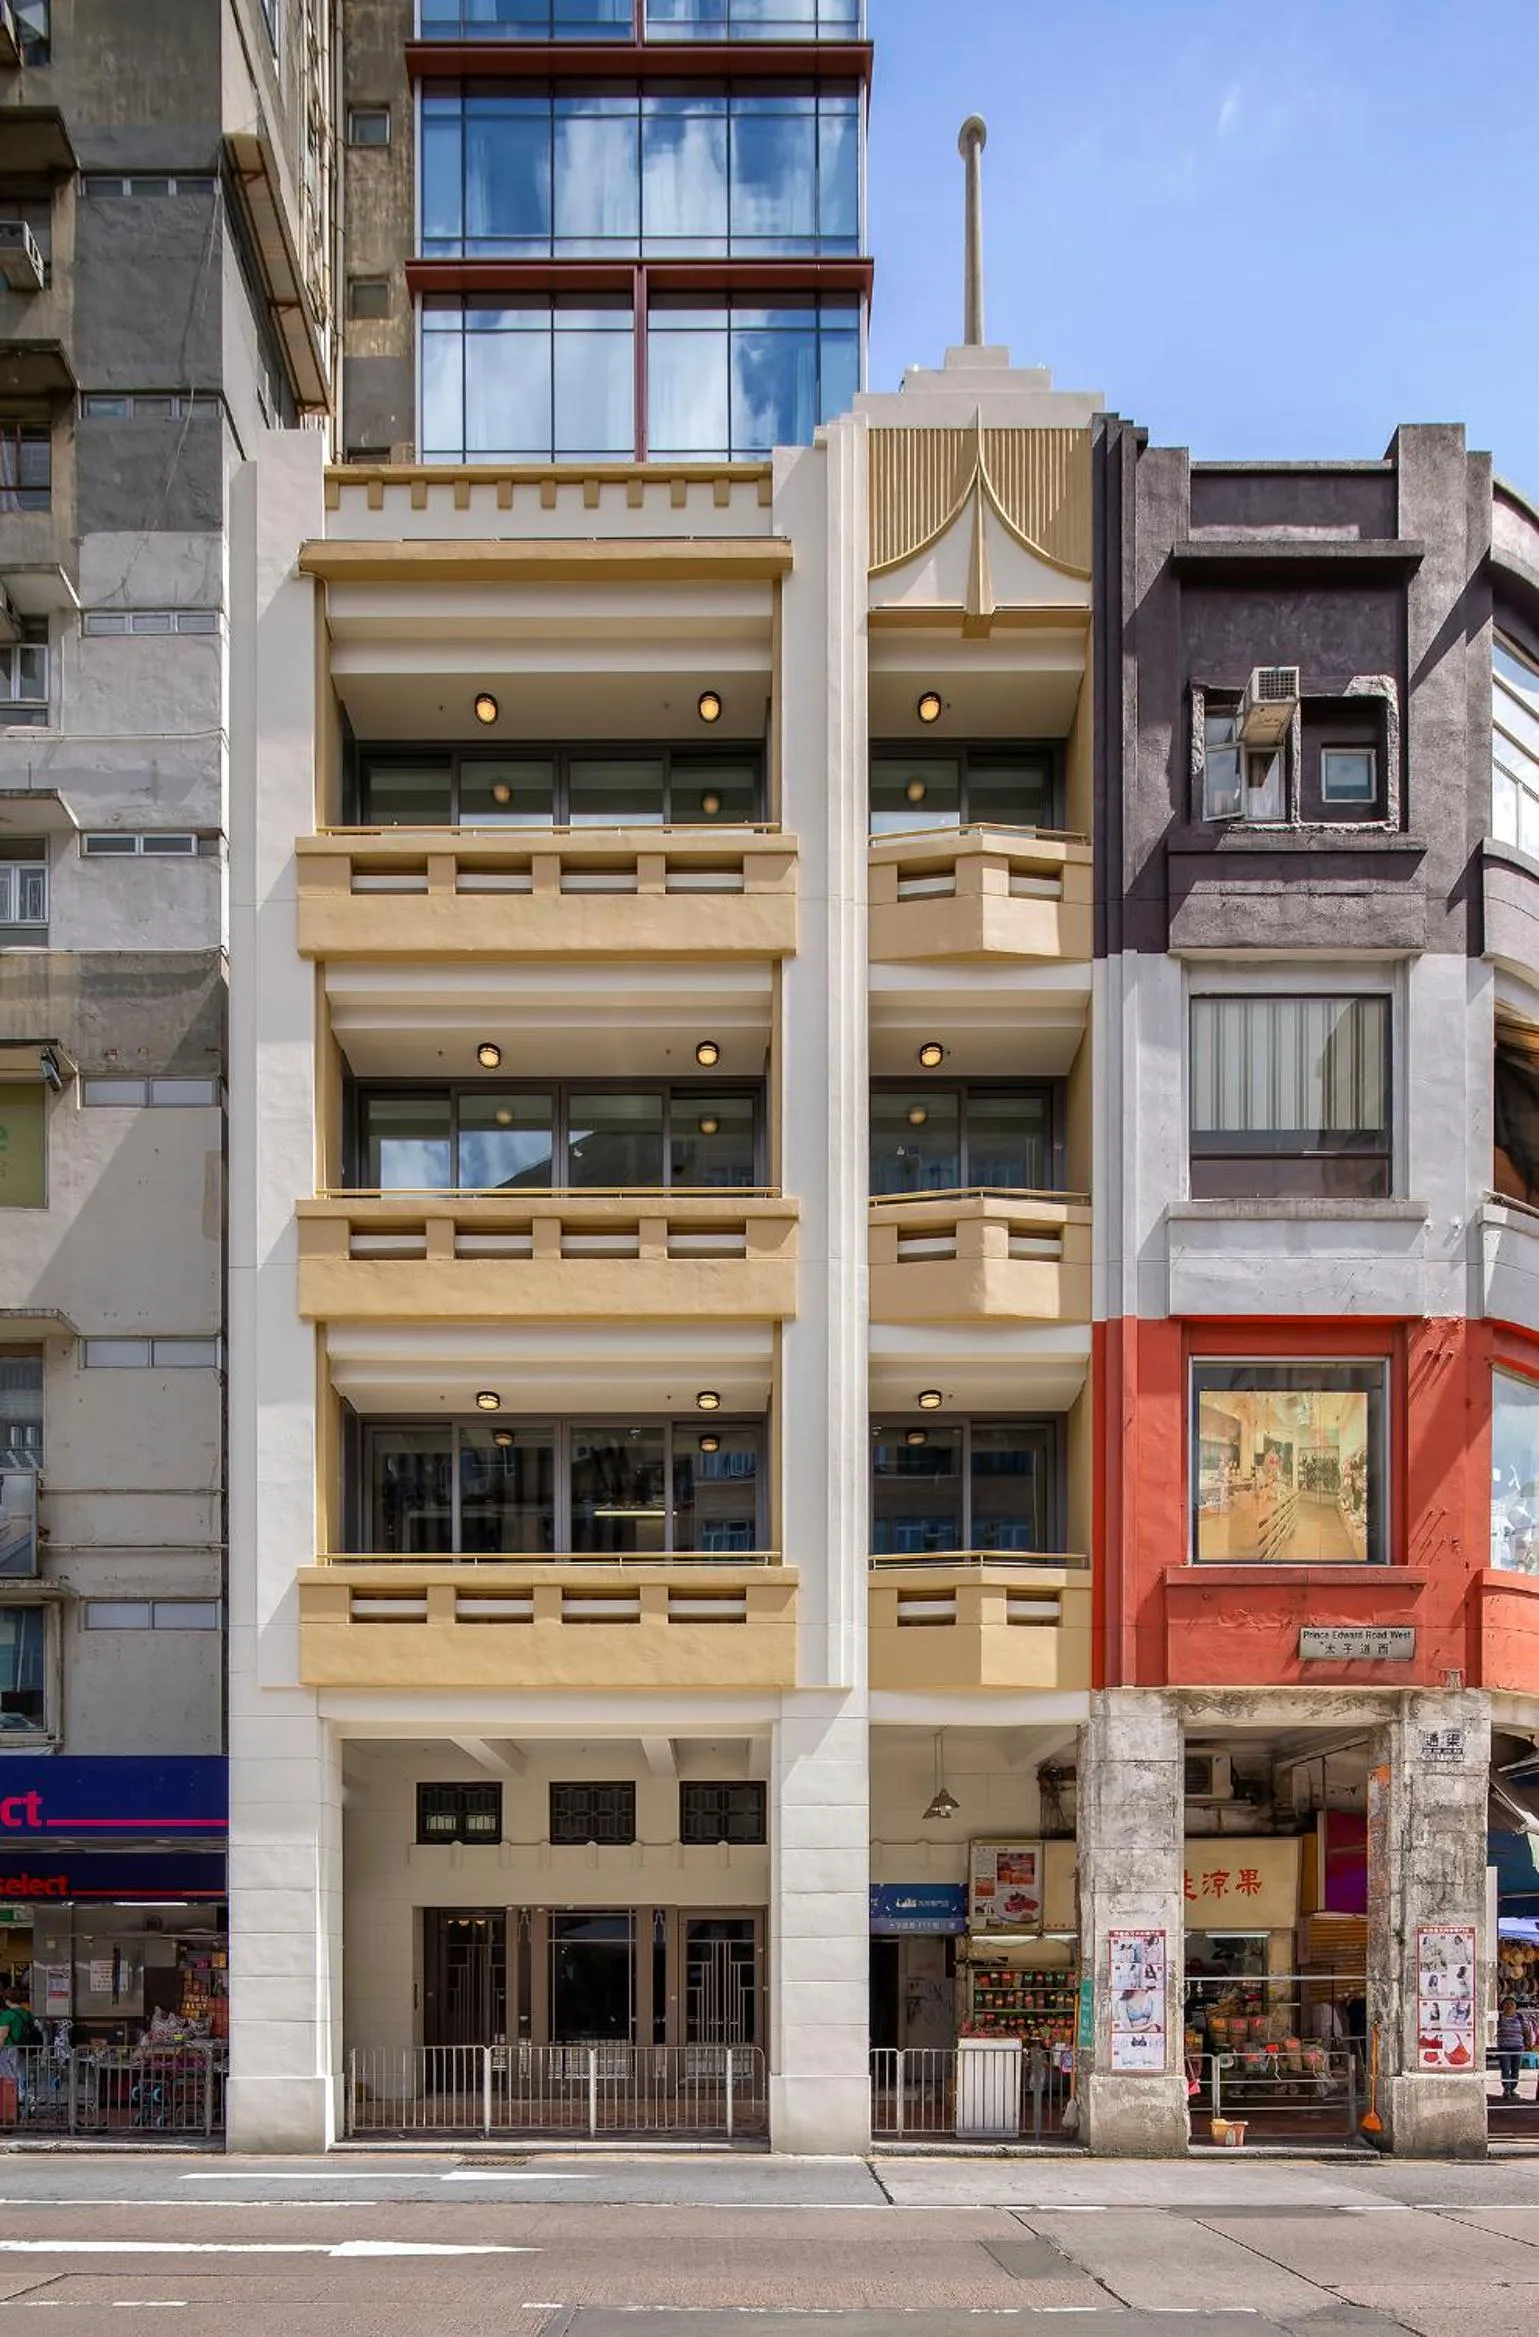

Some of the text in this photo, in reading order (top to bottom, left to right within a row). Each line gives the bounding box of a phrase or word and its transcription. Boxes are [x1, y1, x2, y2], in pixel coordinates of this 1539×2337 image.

[1302, 1629, 1411, 1640] Prince Edward Road West
[1324, 1642, 1389, 1655] 太子道西
